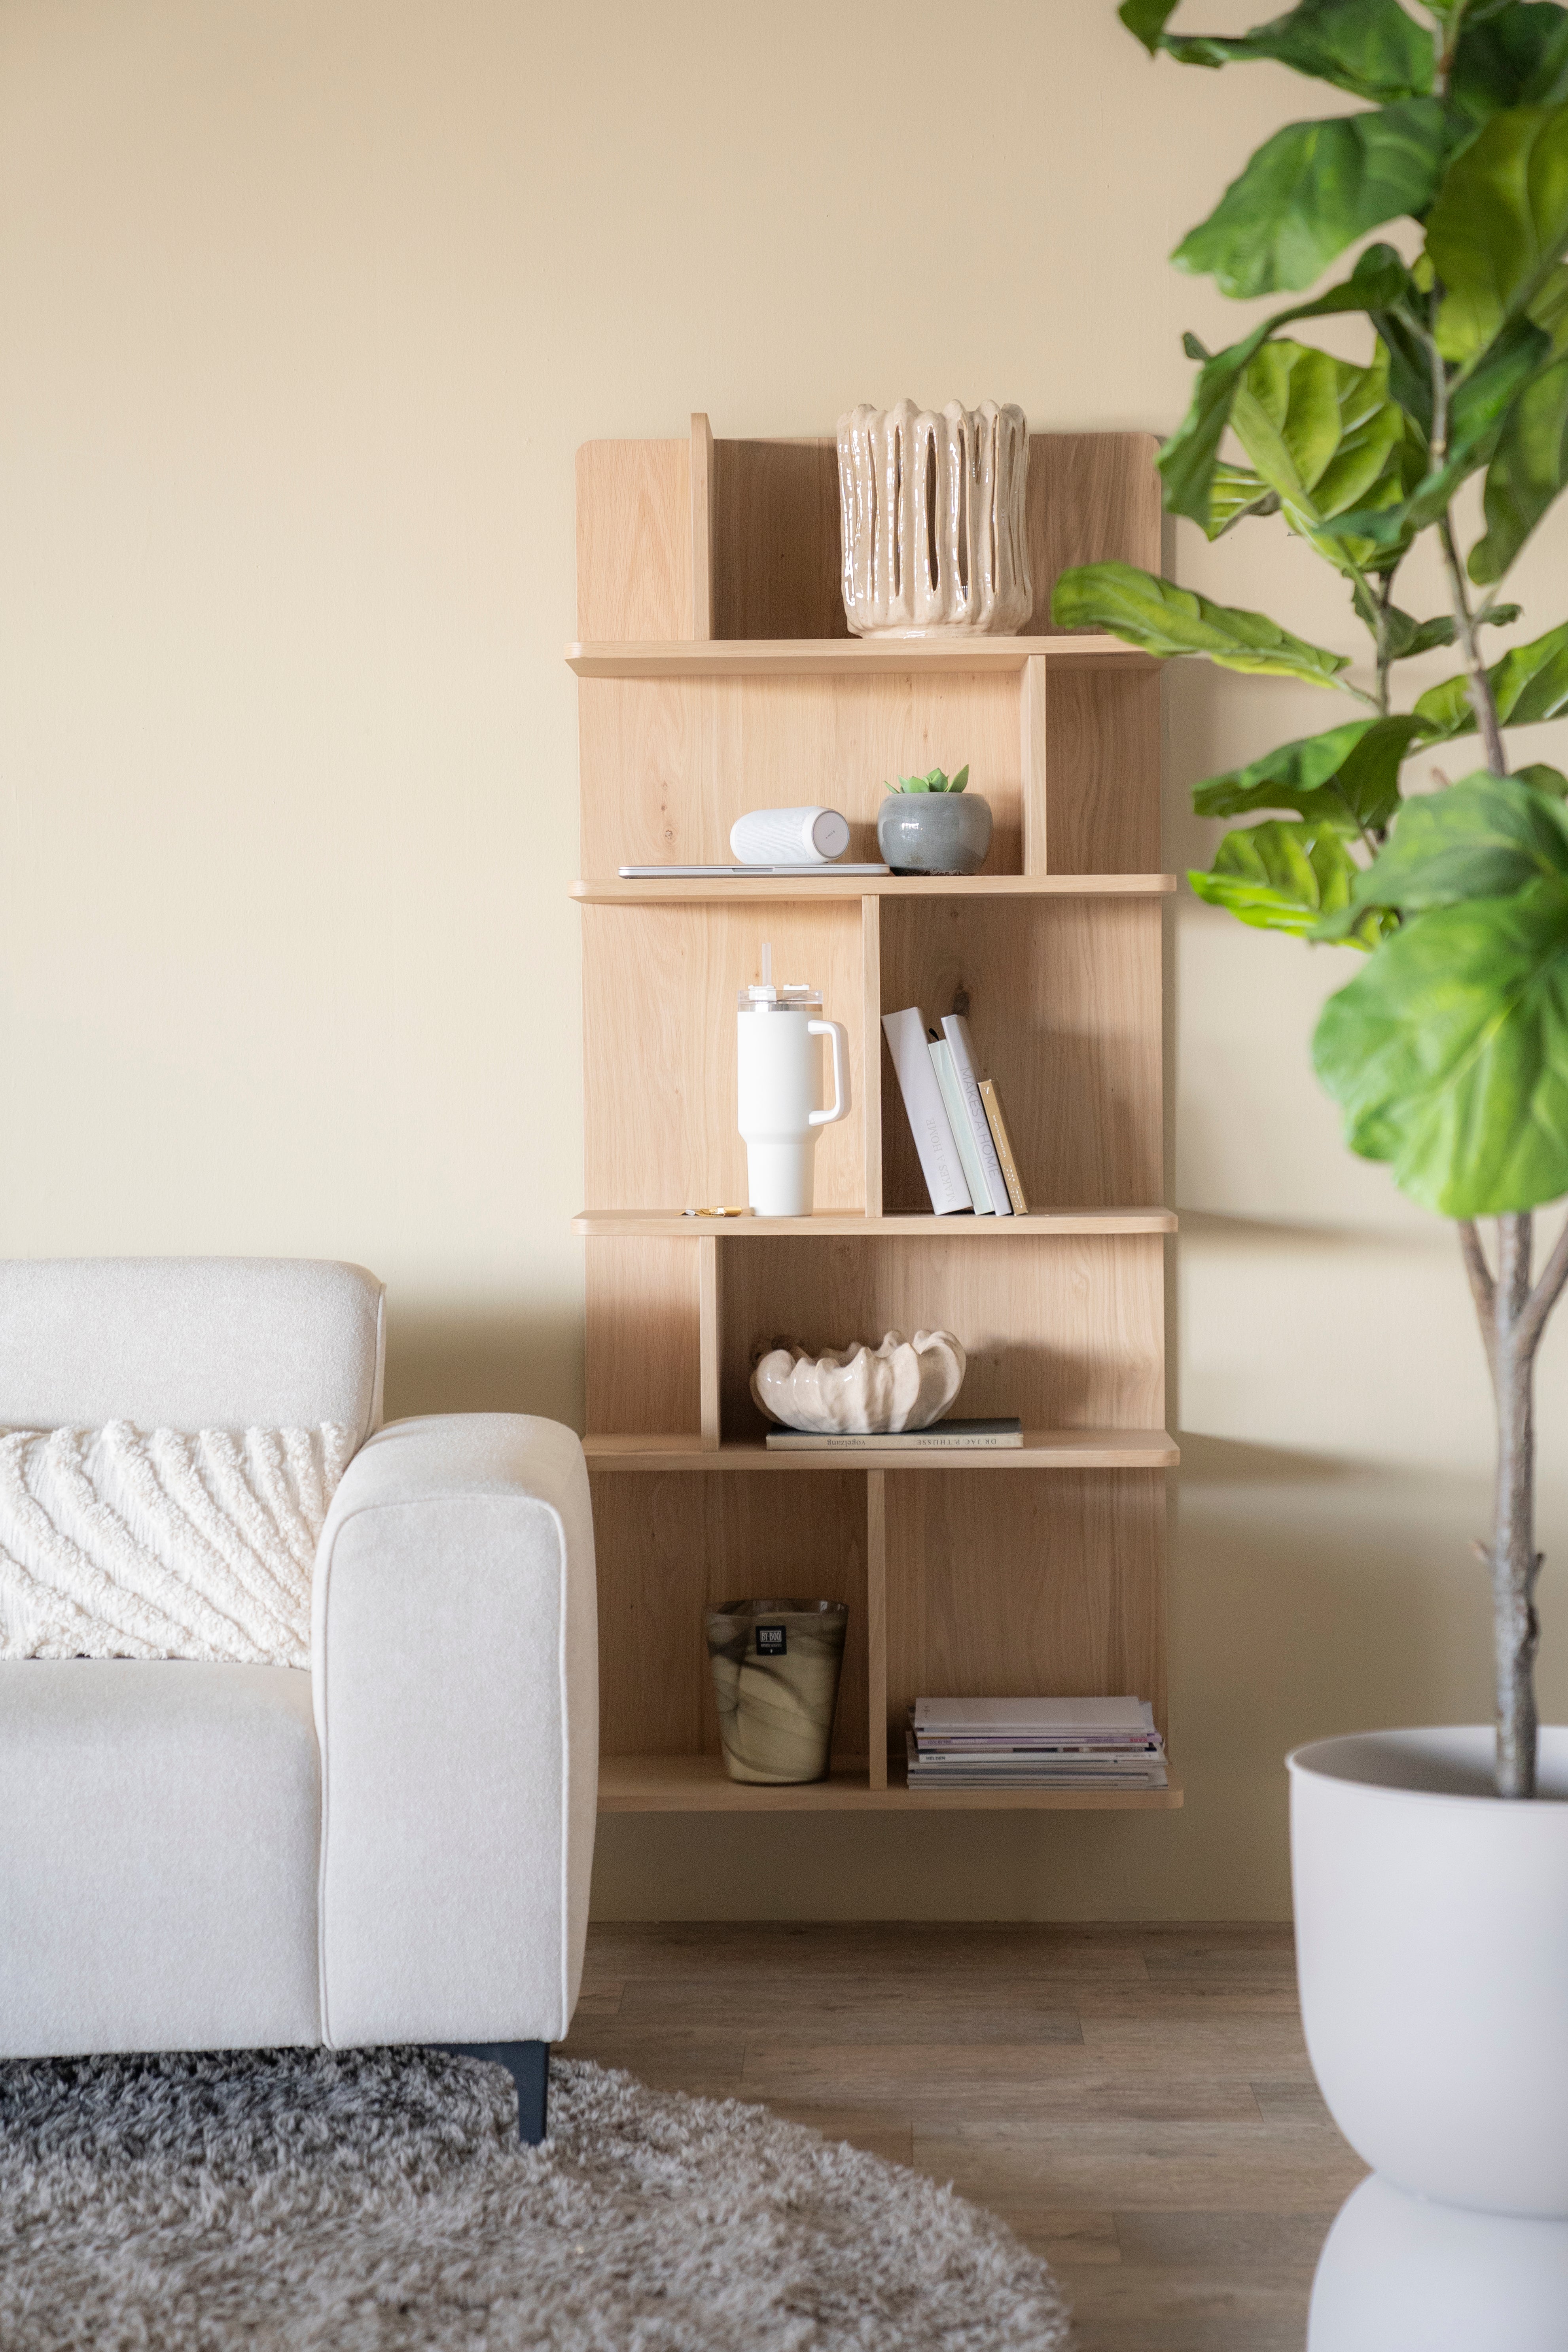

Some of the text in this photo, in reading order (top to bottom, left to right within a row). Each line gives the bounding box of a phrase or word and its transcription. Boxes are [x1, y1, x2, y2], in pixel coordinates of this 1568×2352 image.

[926, 1118, 956, 1203] MAKES A HOME
[960, 1067, 1000, 1178] MAKES A HOME
